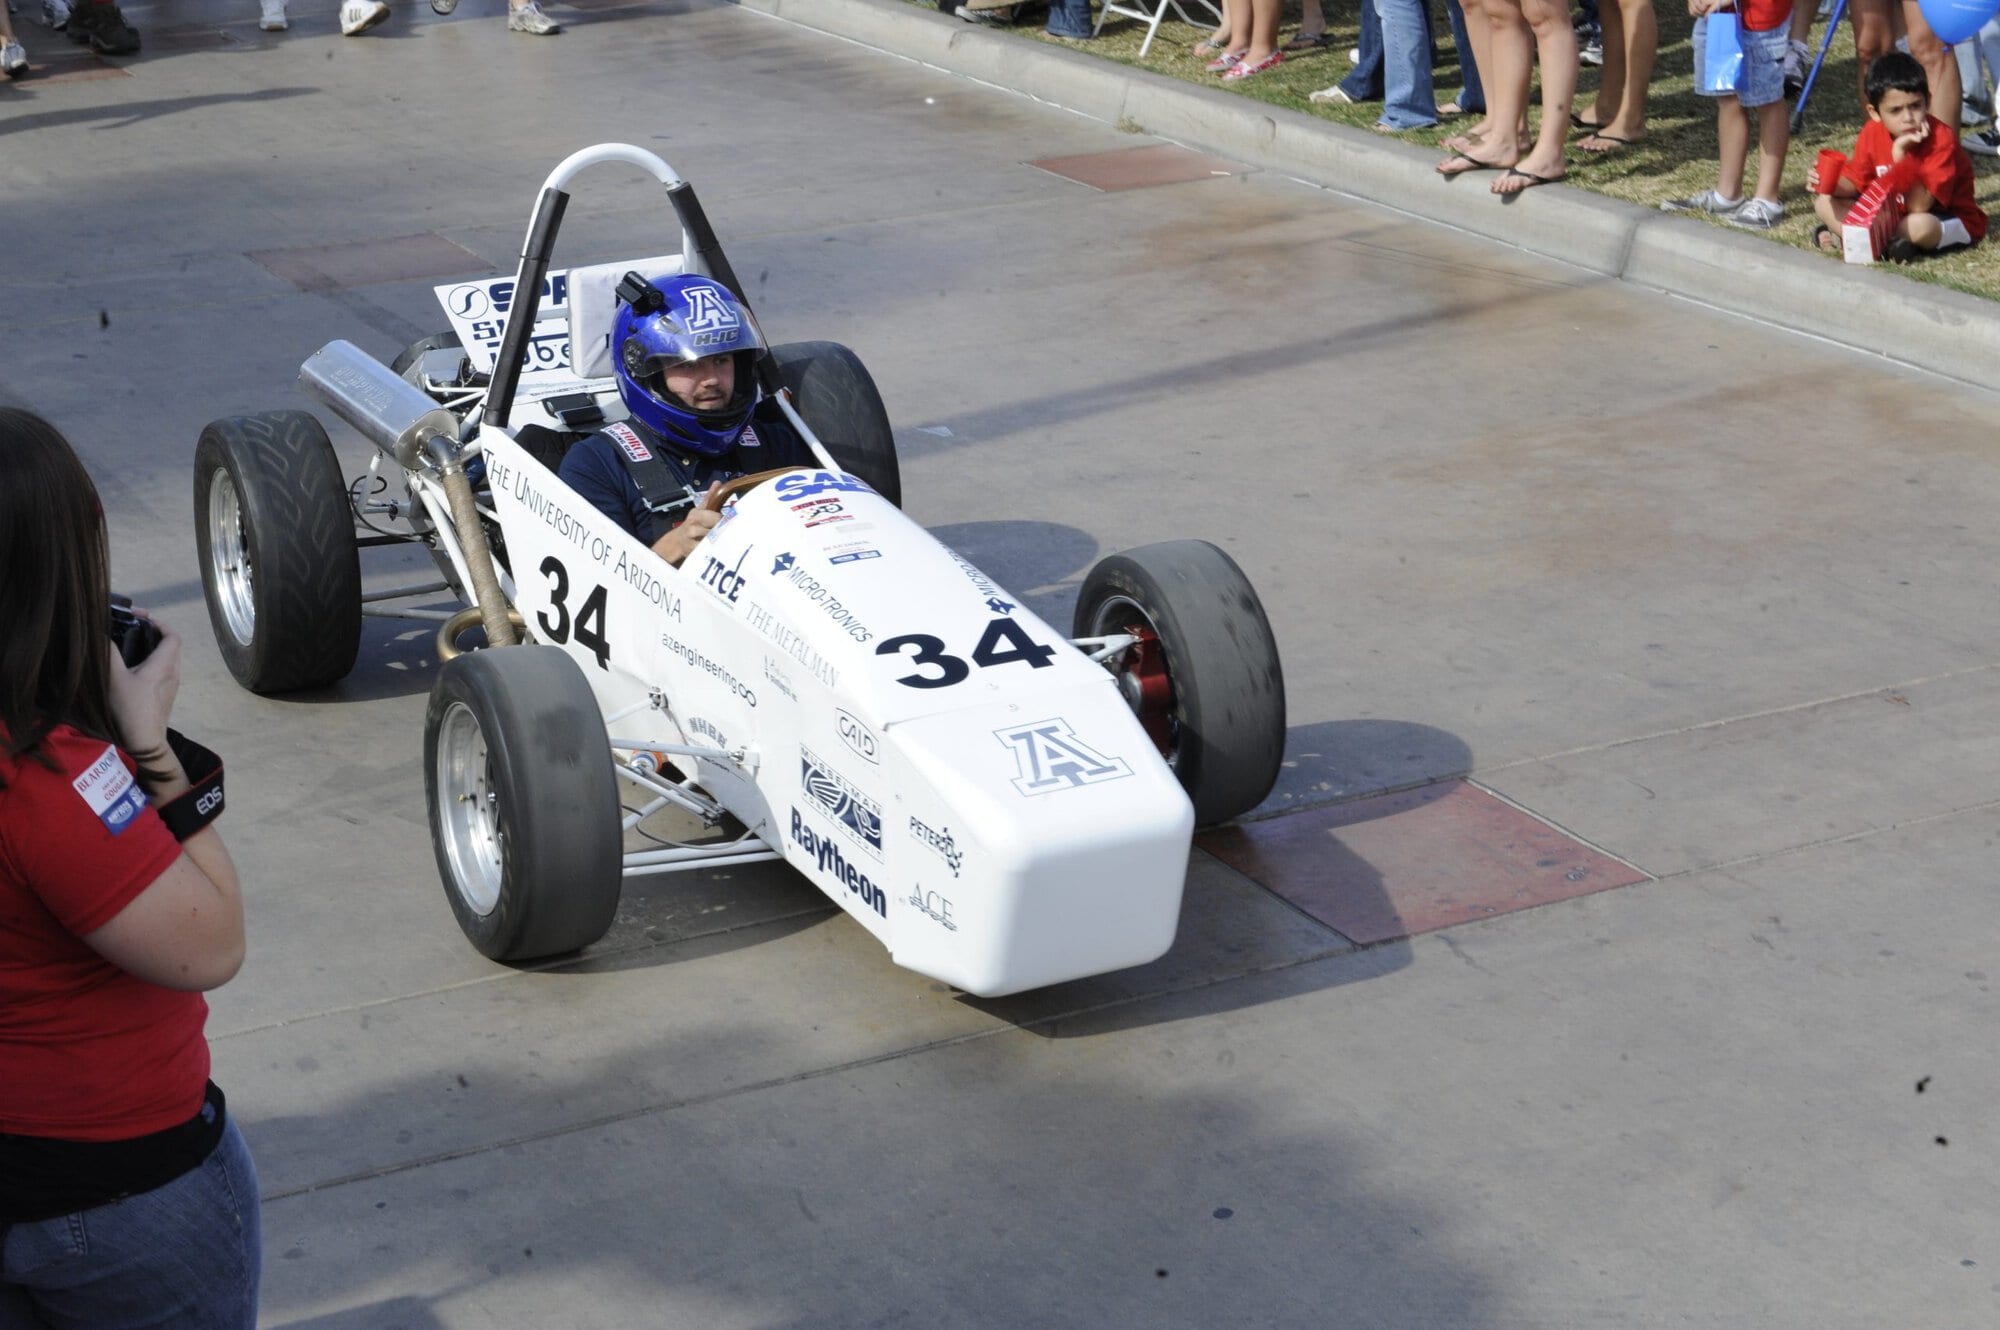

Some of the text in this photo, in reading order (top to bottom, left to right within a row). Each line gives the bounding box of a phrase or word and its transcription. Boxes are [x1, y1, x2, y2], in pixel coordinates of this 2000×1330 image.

[693, 329, 739, 347] HJC
[484, 448, 511, 491] THE
[514, 471, 590, 550] UNIVERSITY
[591, 537, 612, 566] OF
[614, 550, 682, 623] ARIZONA
[537, 556, 611, 672] 34
[786, 566, 873, 643] MICRO-TRONICS
[662, 633, 738, 695] azengineering
[811, 651, 841, 688] MAN
[875, 617, 1057, 689] 34
[839, 716, 875, 757] CAID
[196, 786, 223, 815] EOS
[791, 804, 887, 919] Raytheon
